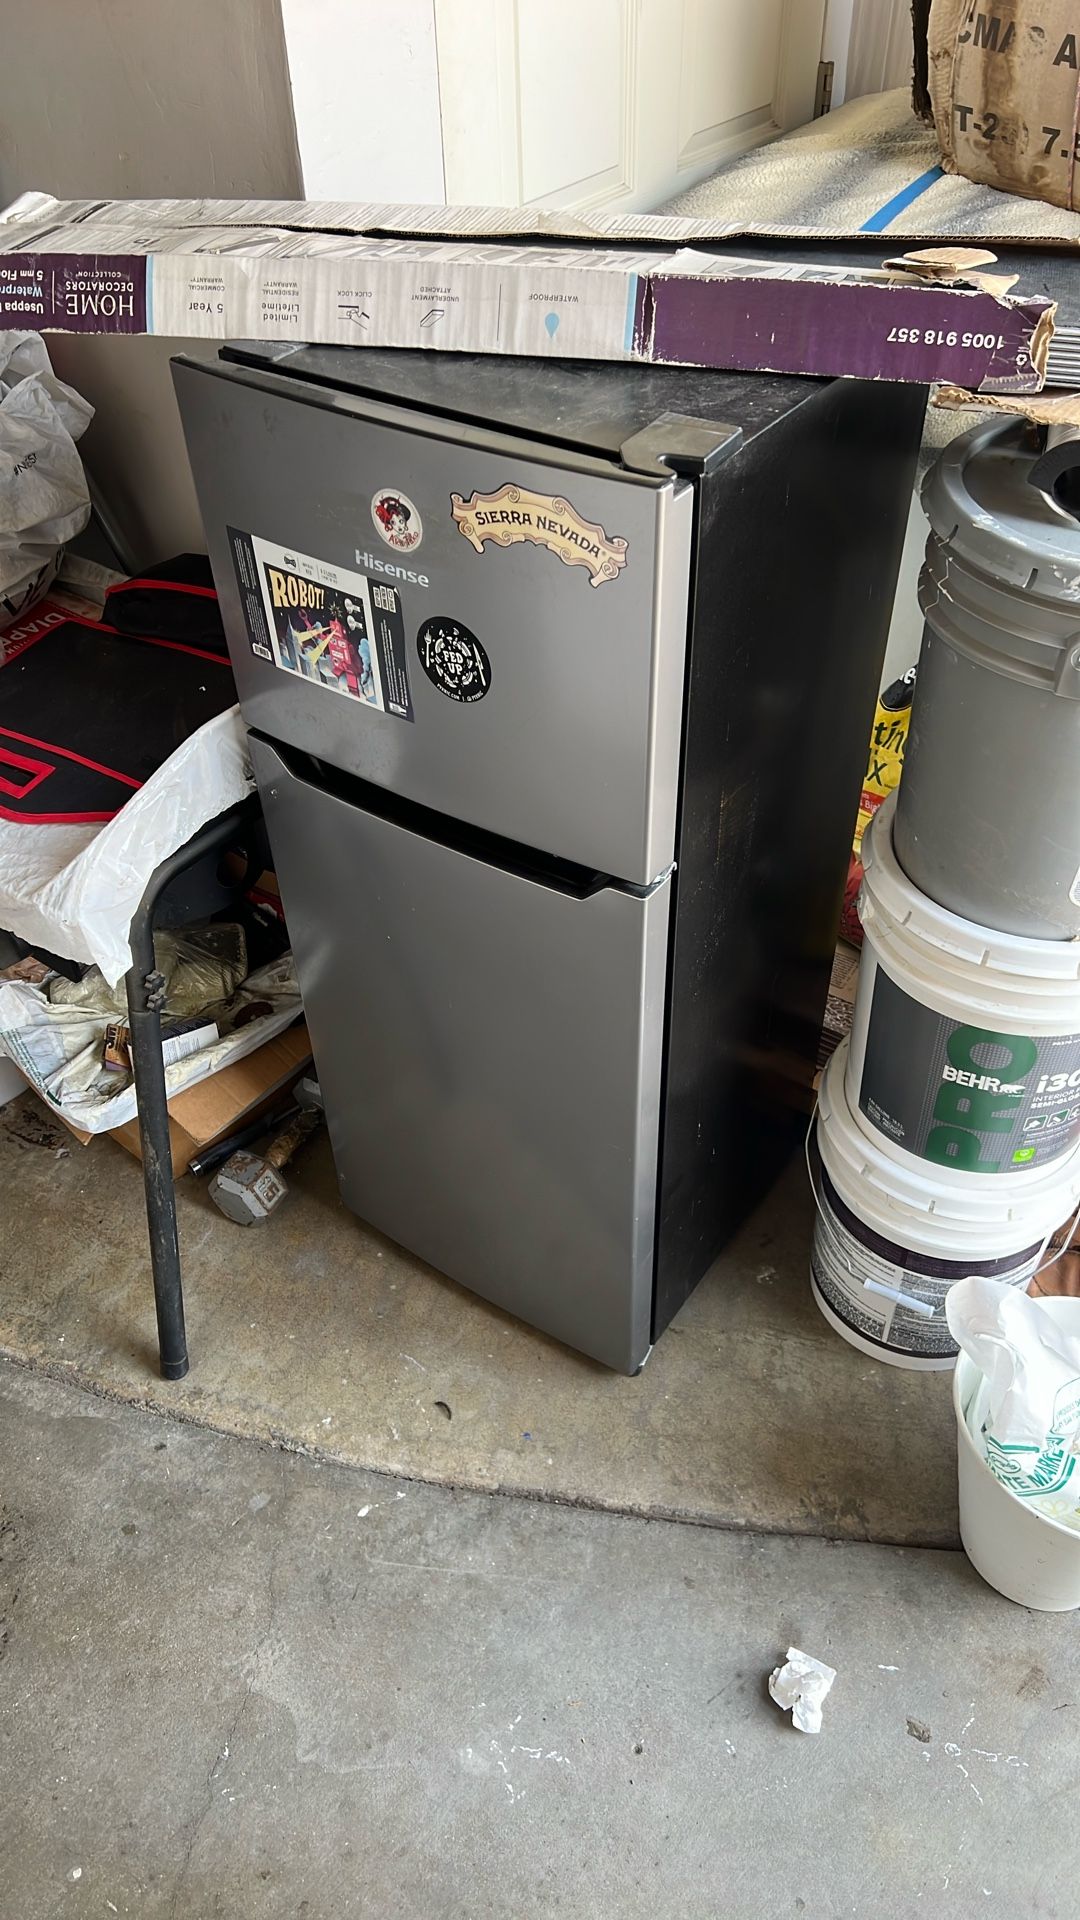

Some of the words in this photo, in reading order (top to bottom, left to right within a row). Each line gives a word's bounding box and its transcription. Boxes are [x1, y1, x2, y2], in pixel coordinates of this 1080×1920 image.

[36, 270, 44, 281] 5
[0, 284, 43, 297] Waterpr
[65, 281, 134, 292] DECORATORS
[188, 284, 225, 292] COMMERCIAL
[262, 288, 299, 297] RESIDENTIAL
[354, 290, 373, 298] CLICK
[411, 294, 460, 303] UNDERLAYMENT
[528, 293, 579, 302] WATERPROOF
[5, 300, 44, 314] Useppa
[66, 294, 134, 317] HOME
[188, 302, 213, 313] Year
[216, 303, 224, 314] 5
[261, 302, 300, 312] Lifetime
[263, 313, 298, 323] Limited
[887, 327, 920, 344] 357
[924, 330, 957, 346] 918
[961, 332, 1005, 350] 1005
[475, 510, 532, 526] SIERRA
[536, 515, 601, 558] NEVADA
[355, 549, 429, 588] Hisense
[268, 568, 325, 609] ROBOT!
[442, 650, 464, 664] FED
[447, 662, 463, 676] UP
[942, 1065, 1001, 1093] BEHR
[1033, 1090, 1073, 1102] INTERIOR
